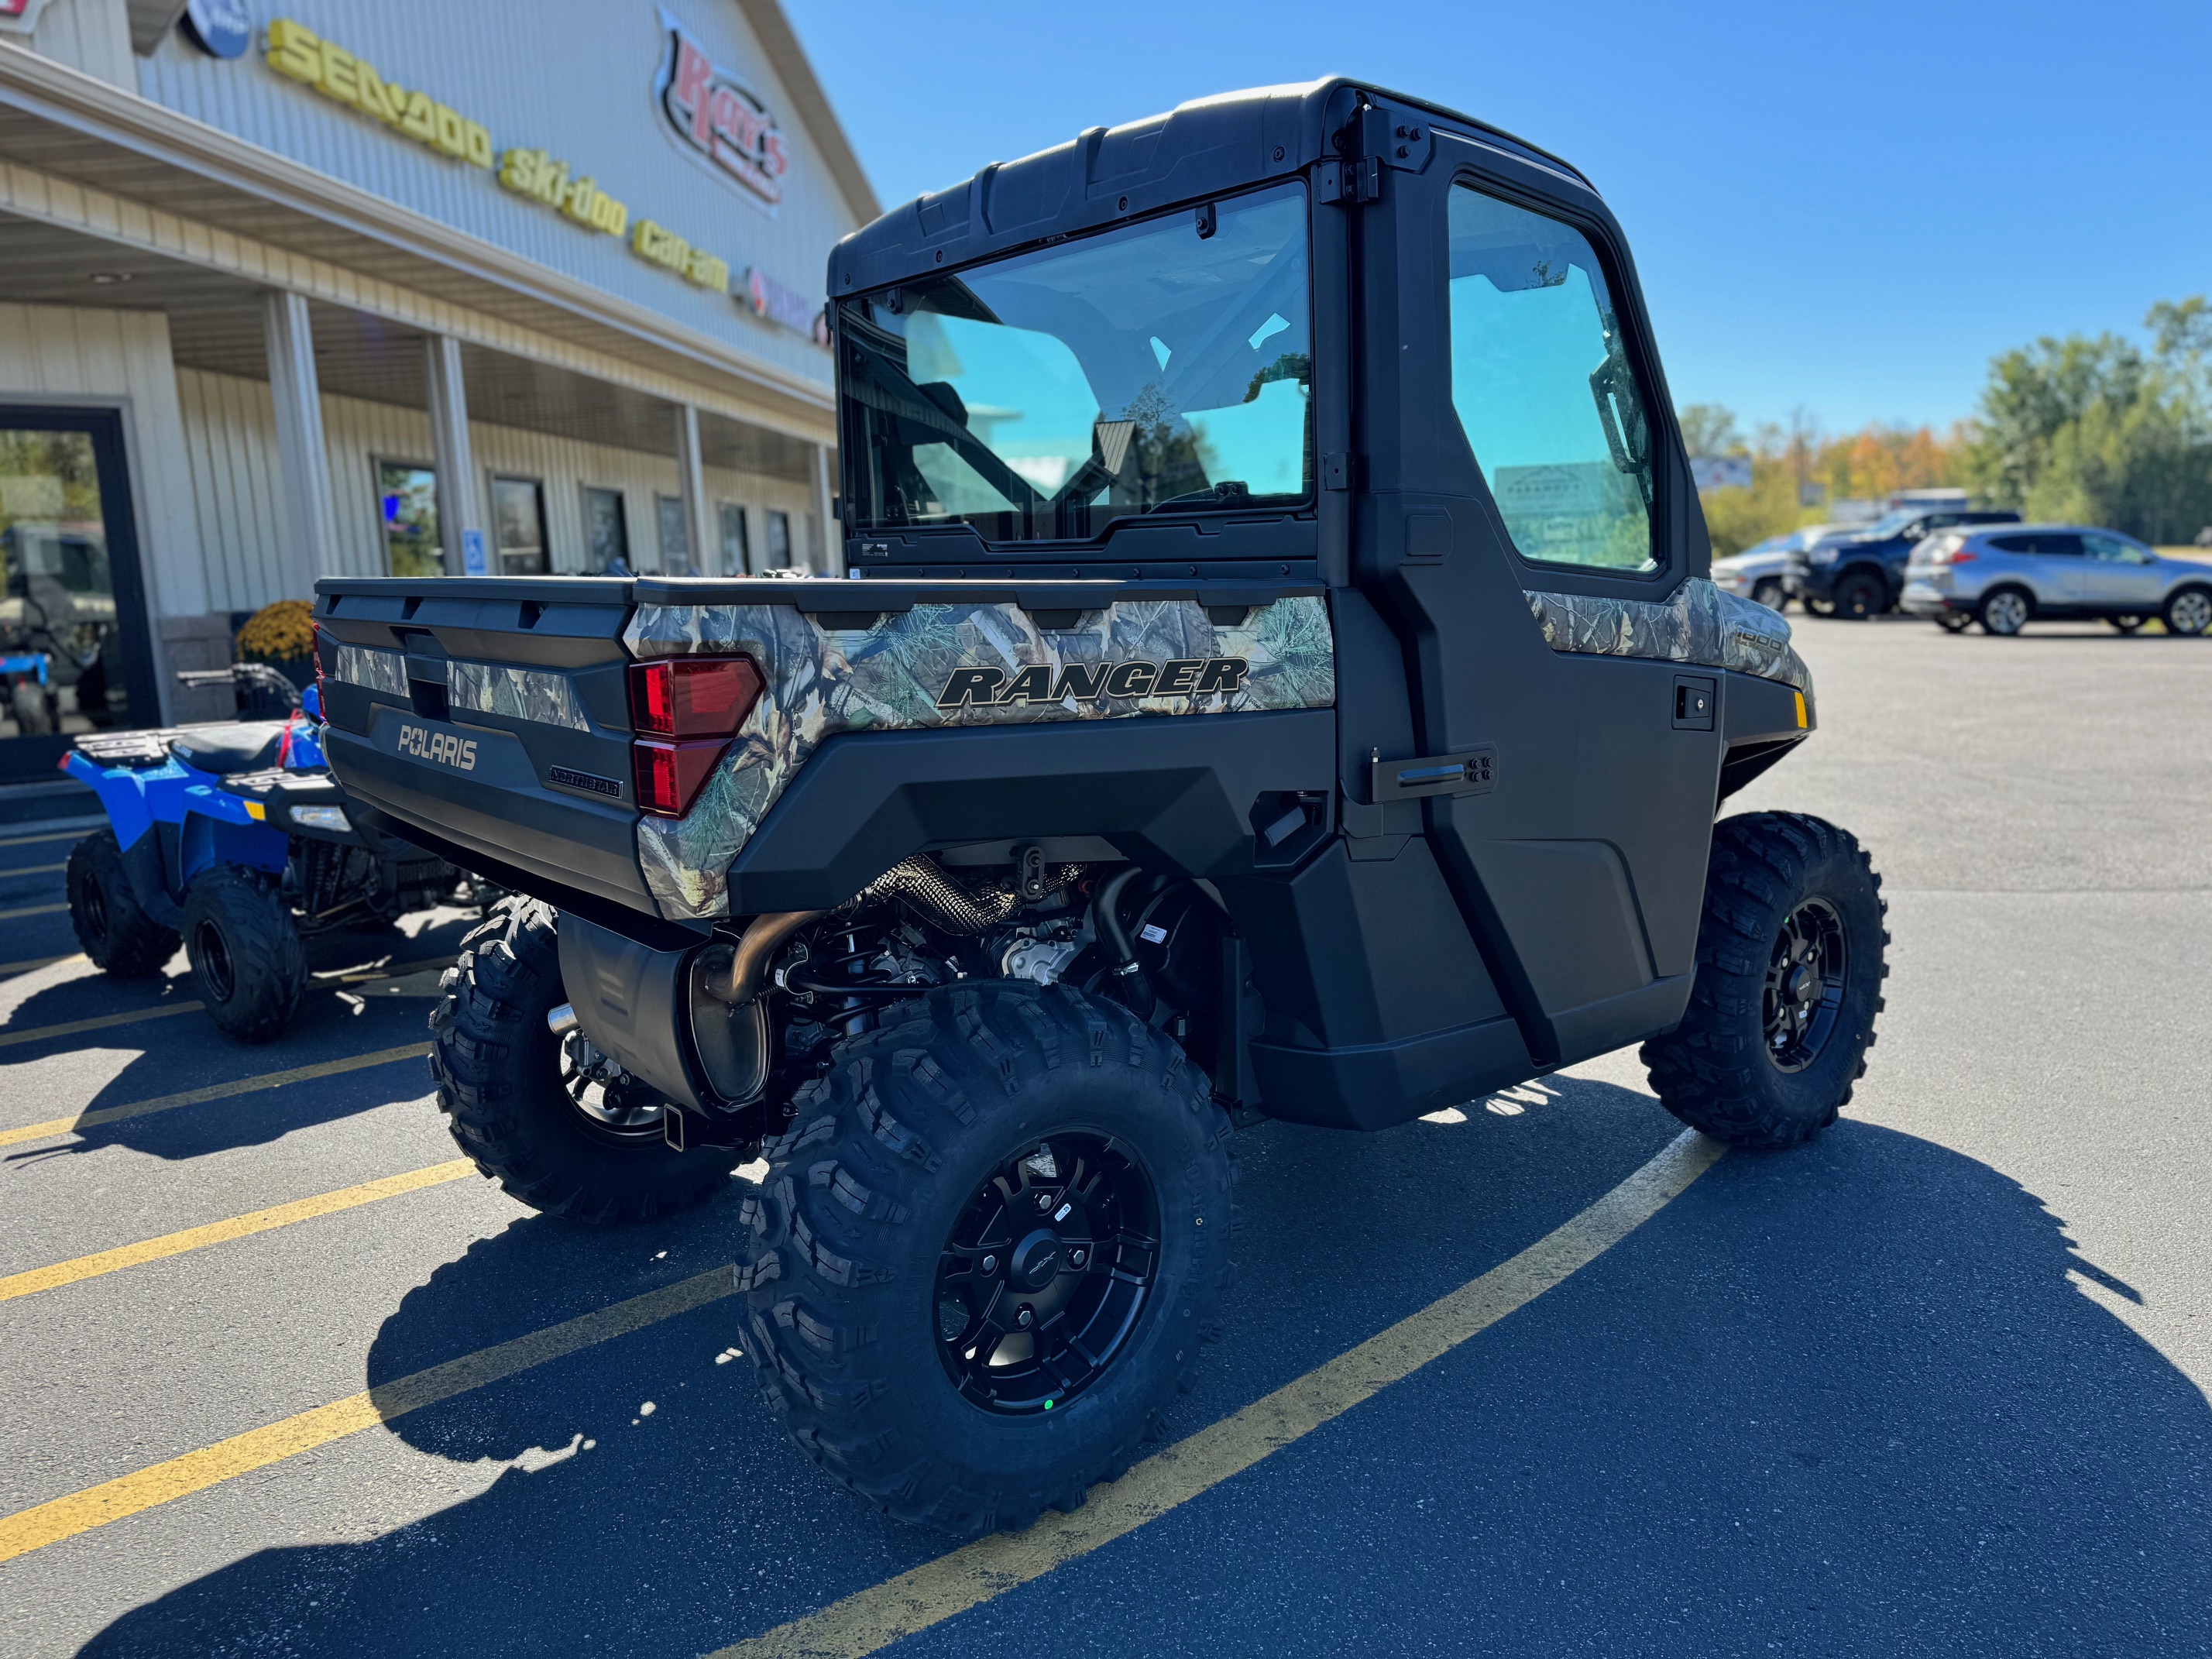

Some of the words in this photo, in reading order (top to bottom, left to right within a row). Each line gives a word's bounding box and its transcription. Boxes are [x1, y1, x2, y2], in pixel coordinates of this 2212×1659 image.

[1736, 625, 1783, 653] 1000
[934, 657, 1249, 709] RANGER
[397, 724, 478, 771] POLARIS
[551, 768, 618, 795] NORTHSTAR
